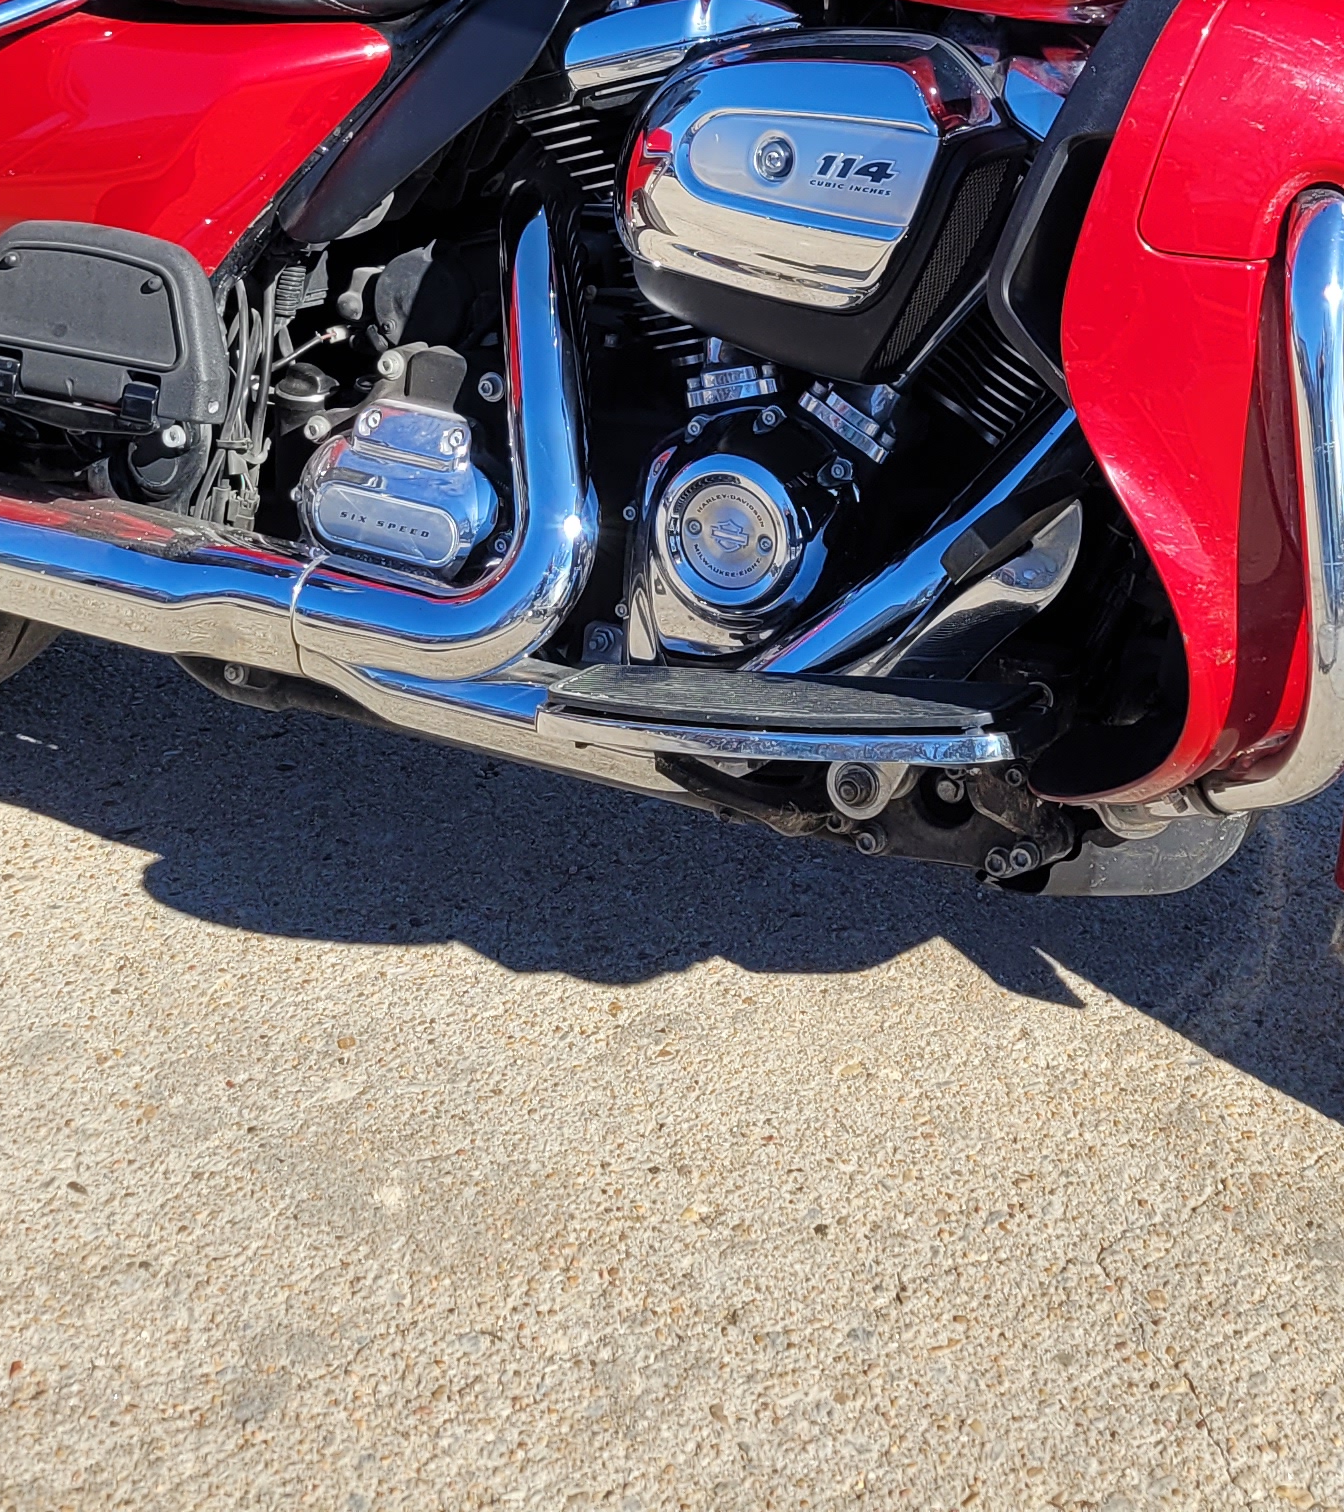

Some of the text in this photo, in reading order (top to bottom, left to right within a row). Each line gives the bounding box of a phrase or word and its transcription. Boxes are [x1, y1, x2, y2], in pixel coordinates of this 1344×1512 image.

[816, 152, 899, 184] 114
[809, 179, 892, 197] CUBIC INCHES
[339, 510, 430, 538] SIX SPEED
